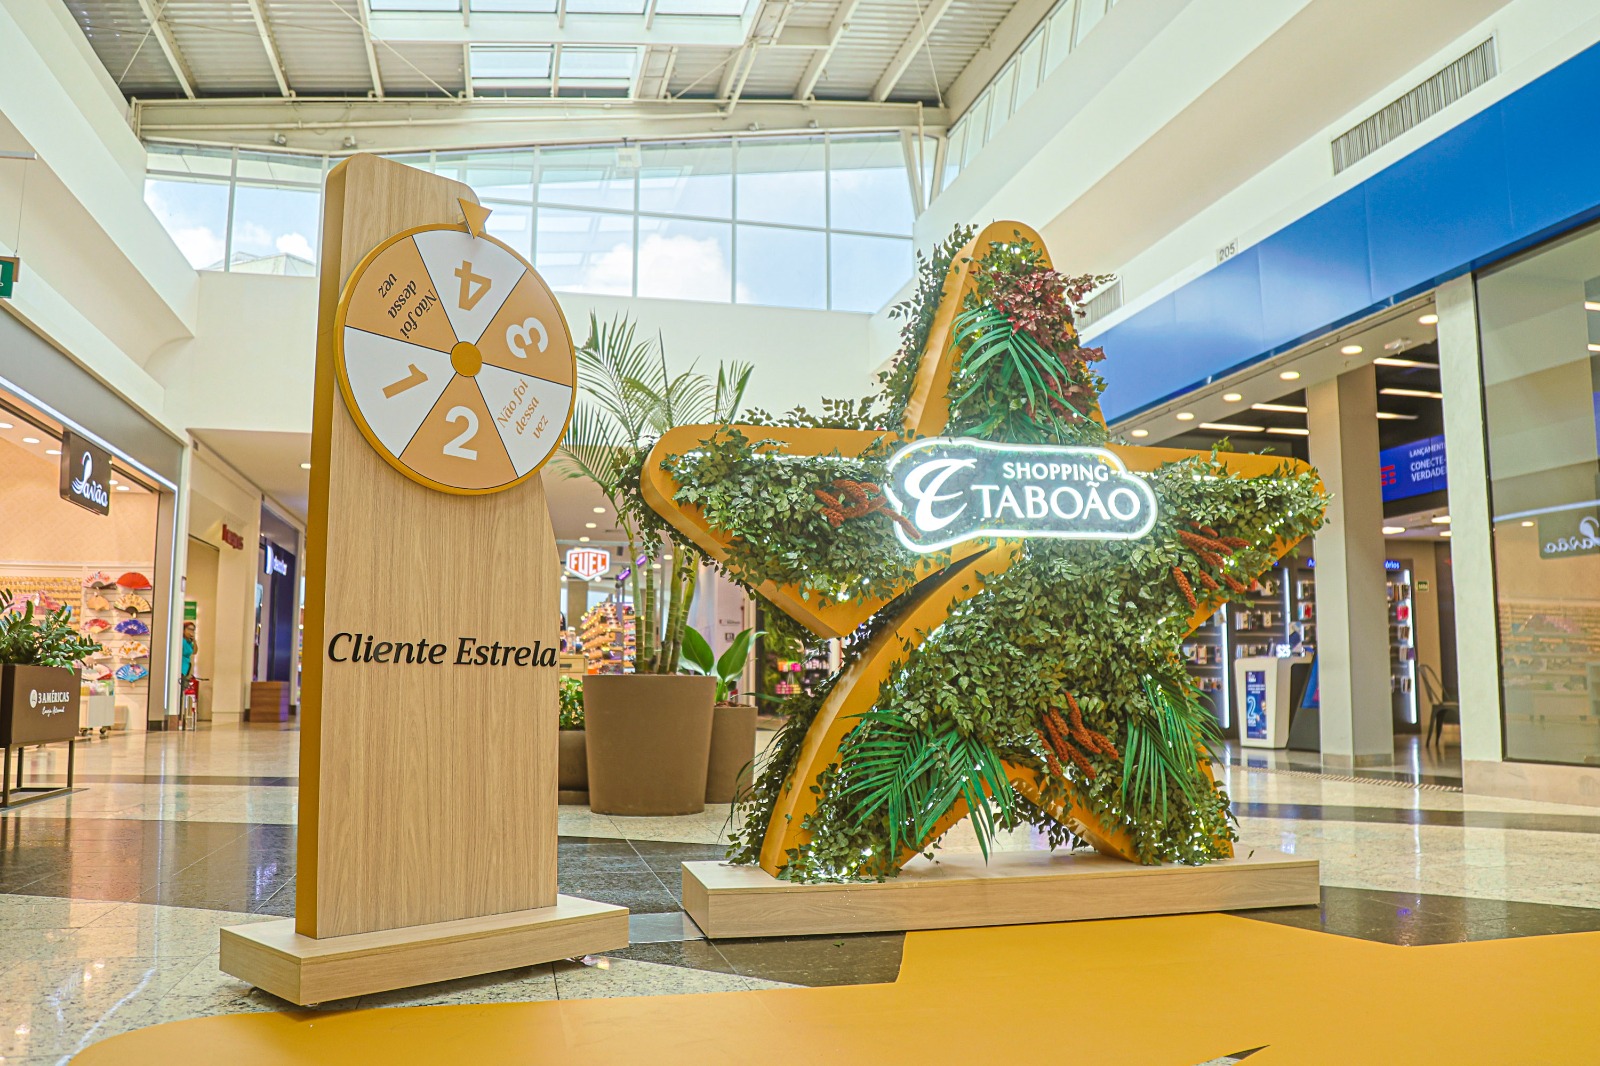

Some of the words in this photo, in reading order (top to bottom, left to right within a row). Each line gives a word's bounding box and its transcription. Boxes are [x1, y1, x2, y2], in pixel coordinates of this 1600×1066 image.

[1219, 242, 1236, 262] 205
[378, 273, 397, 298] vez
[387, 280, 417, 319] dessa
[414, 288, 437, 317] Não
[454, 260, 492, 312] 4
[400, 311, 418, 339] foi
[505, 317, 548, 359] 3
[382, 363, 429, 399] 1
[497, 400, 517, 428] Não
[513, 379, 529, 405] foi
[516, 397, 539, 435] dessa
[442, 405, 479, 461] 2
[533, 415, 549, 439] vez
[1003, 461, 1109, 482] SHOPPING
[970, 481, 1141, 521] TABOÃO
[570, 552, 607, 577] FUEL
[327, 632, 447, 664] Cliente
[453, 637, 558, 667] Estrela
